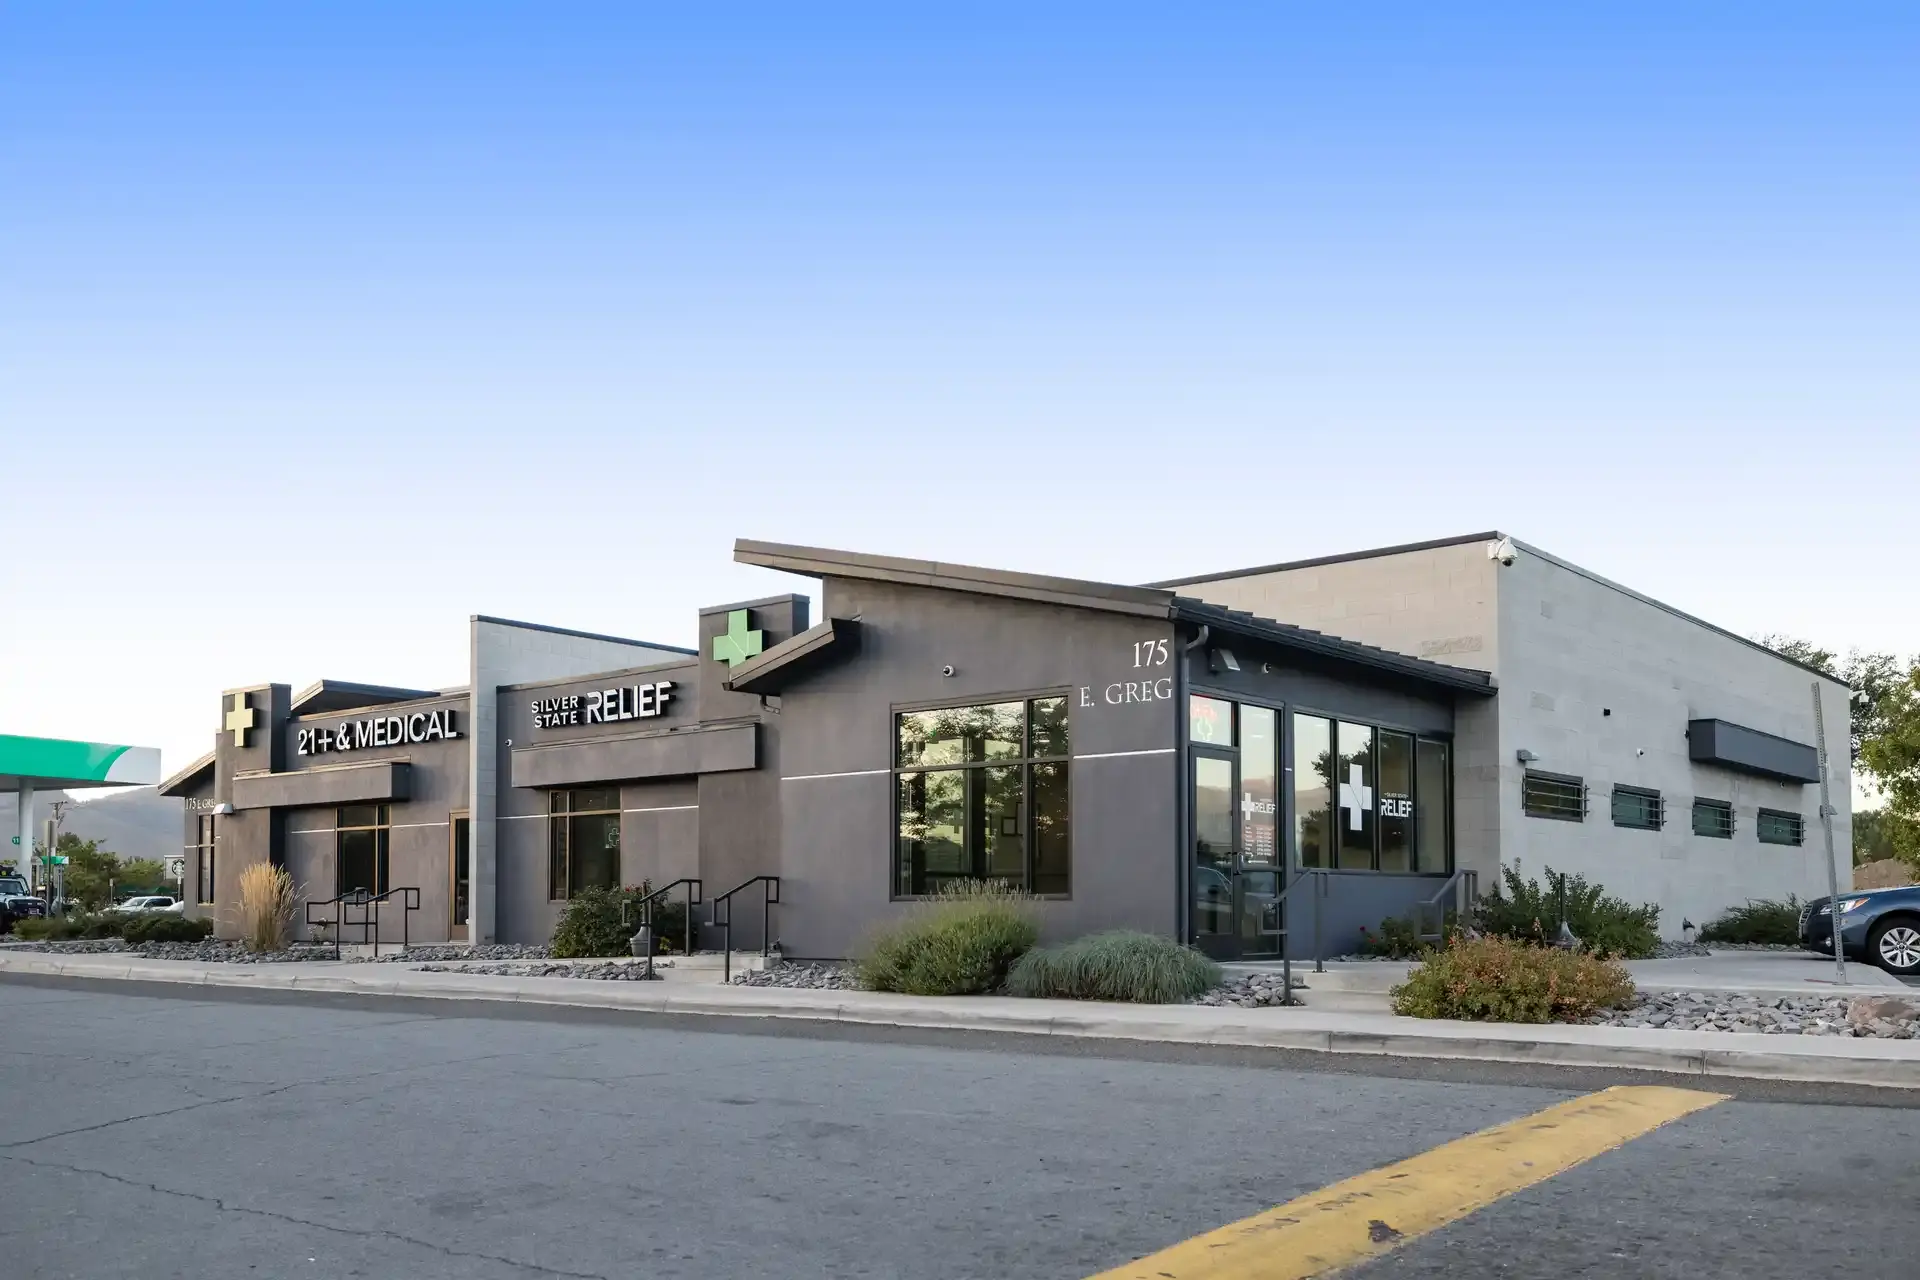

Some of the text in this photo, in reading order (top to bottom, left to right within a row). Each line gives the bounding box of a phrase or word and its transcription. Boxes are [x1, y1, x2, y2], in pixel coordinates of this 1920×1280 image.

[1133, 639, 1168, 668] 175
[1080, 676, 1173, 707] E. GREG
[531, 695, 579, 714] SILVER
[587, 681, 672, 724] RELIEF
[534, 710, 578, 728] STATE
[298, 709, 457, 755] 21+ & MEDICAL
[185, 797, 197, 810] 175
[1253, 802, 1276, 814] RELIEF
[1380, 798, 1412, 818] RELIEF
